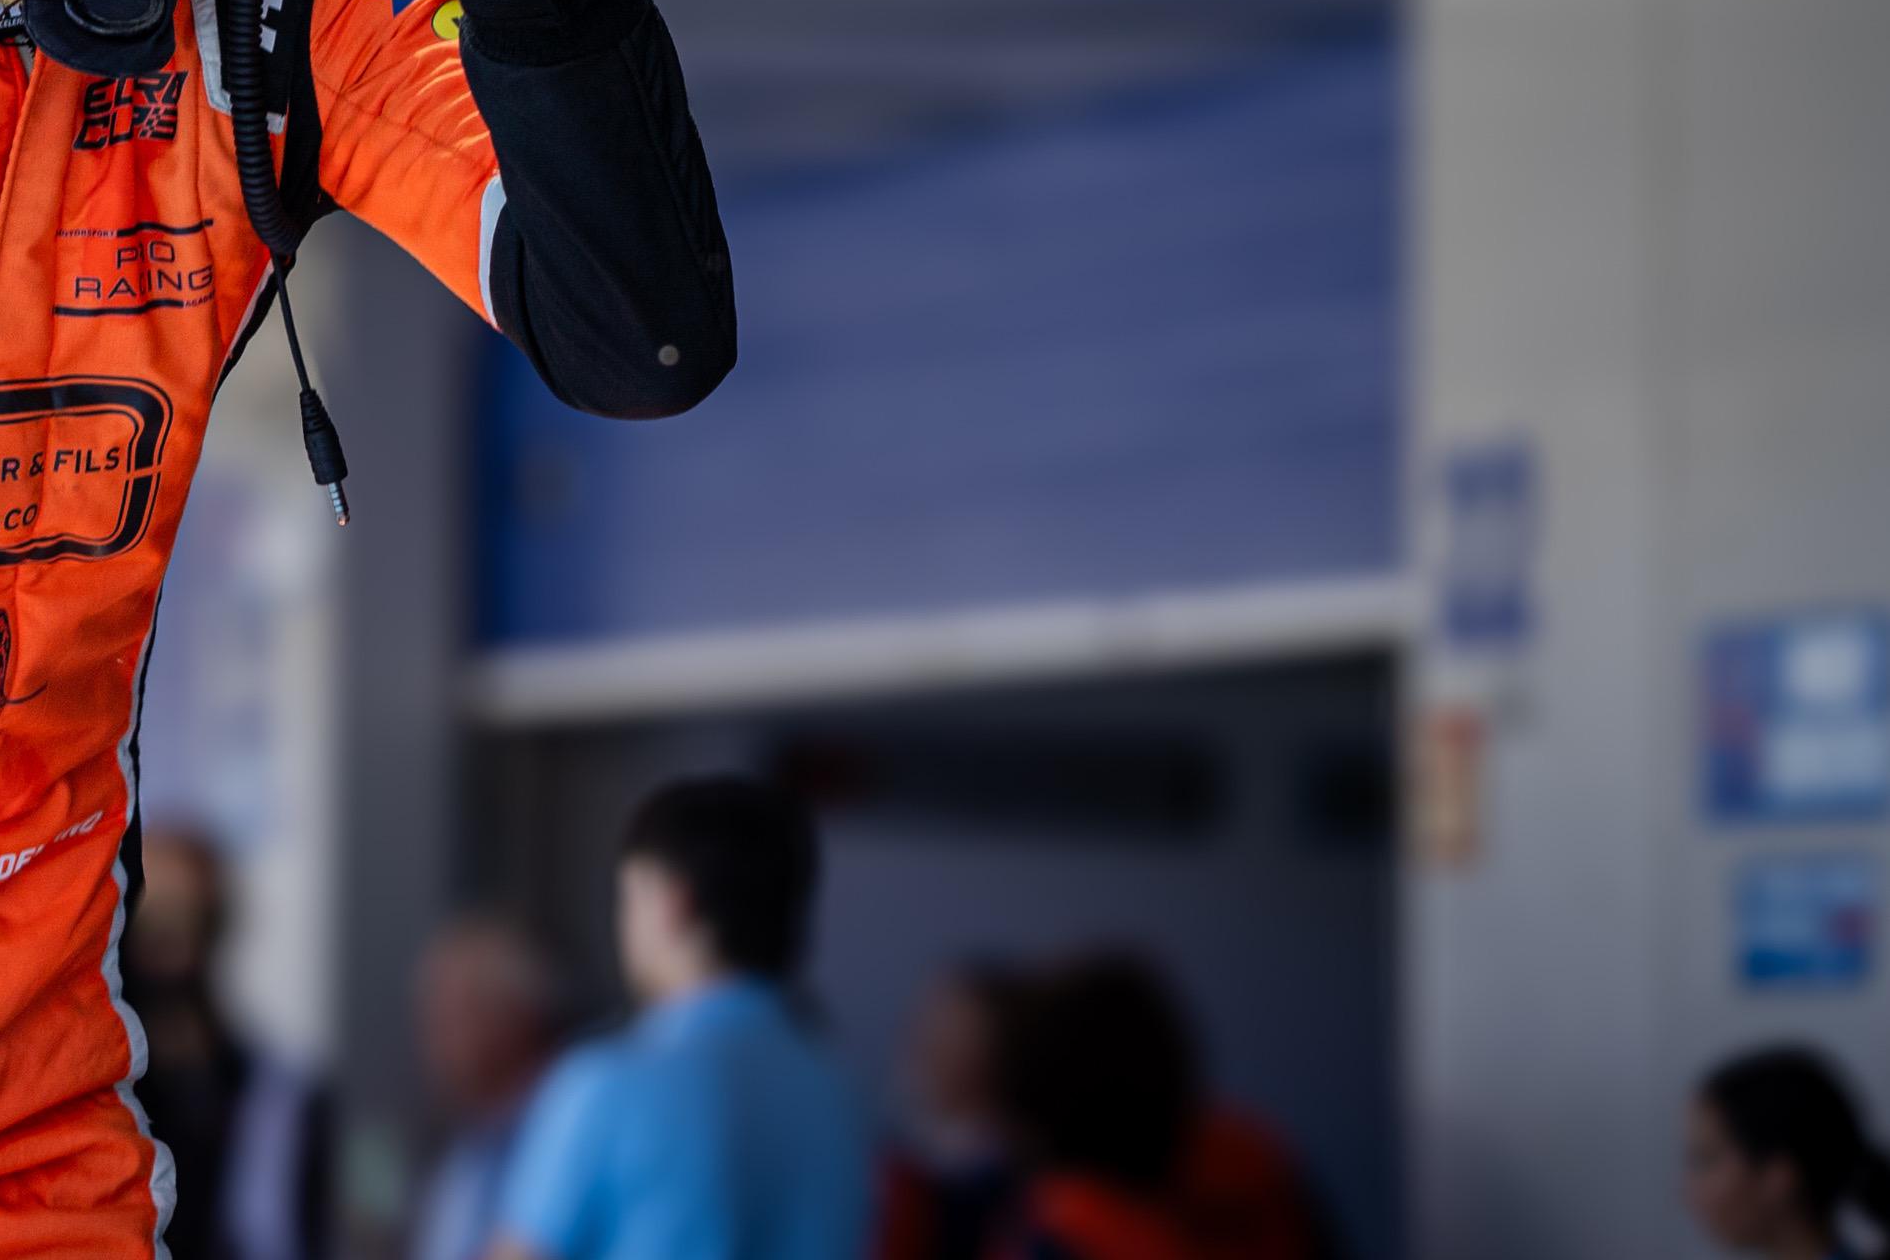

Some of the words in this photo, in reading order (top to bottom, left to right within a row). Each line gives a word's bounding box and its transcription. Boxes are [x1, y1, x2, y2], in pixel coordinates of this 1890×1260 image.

[117, 241, 175, 270] PO
[30, 453, 45, 475] &
[53, 446, 121, 472] FILS
